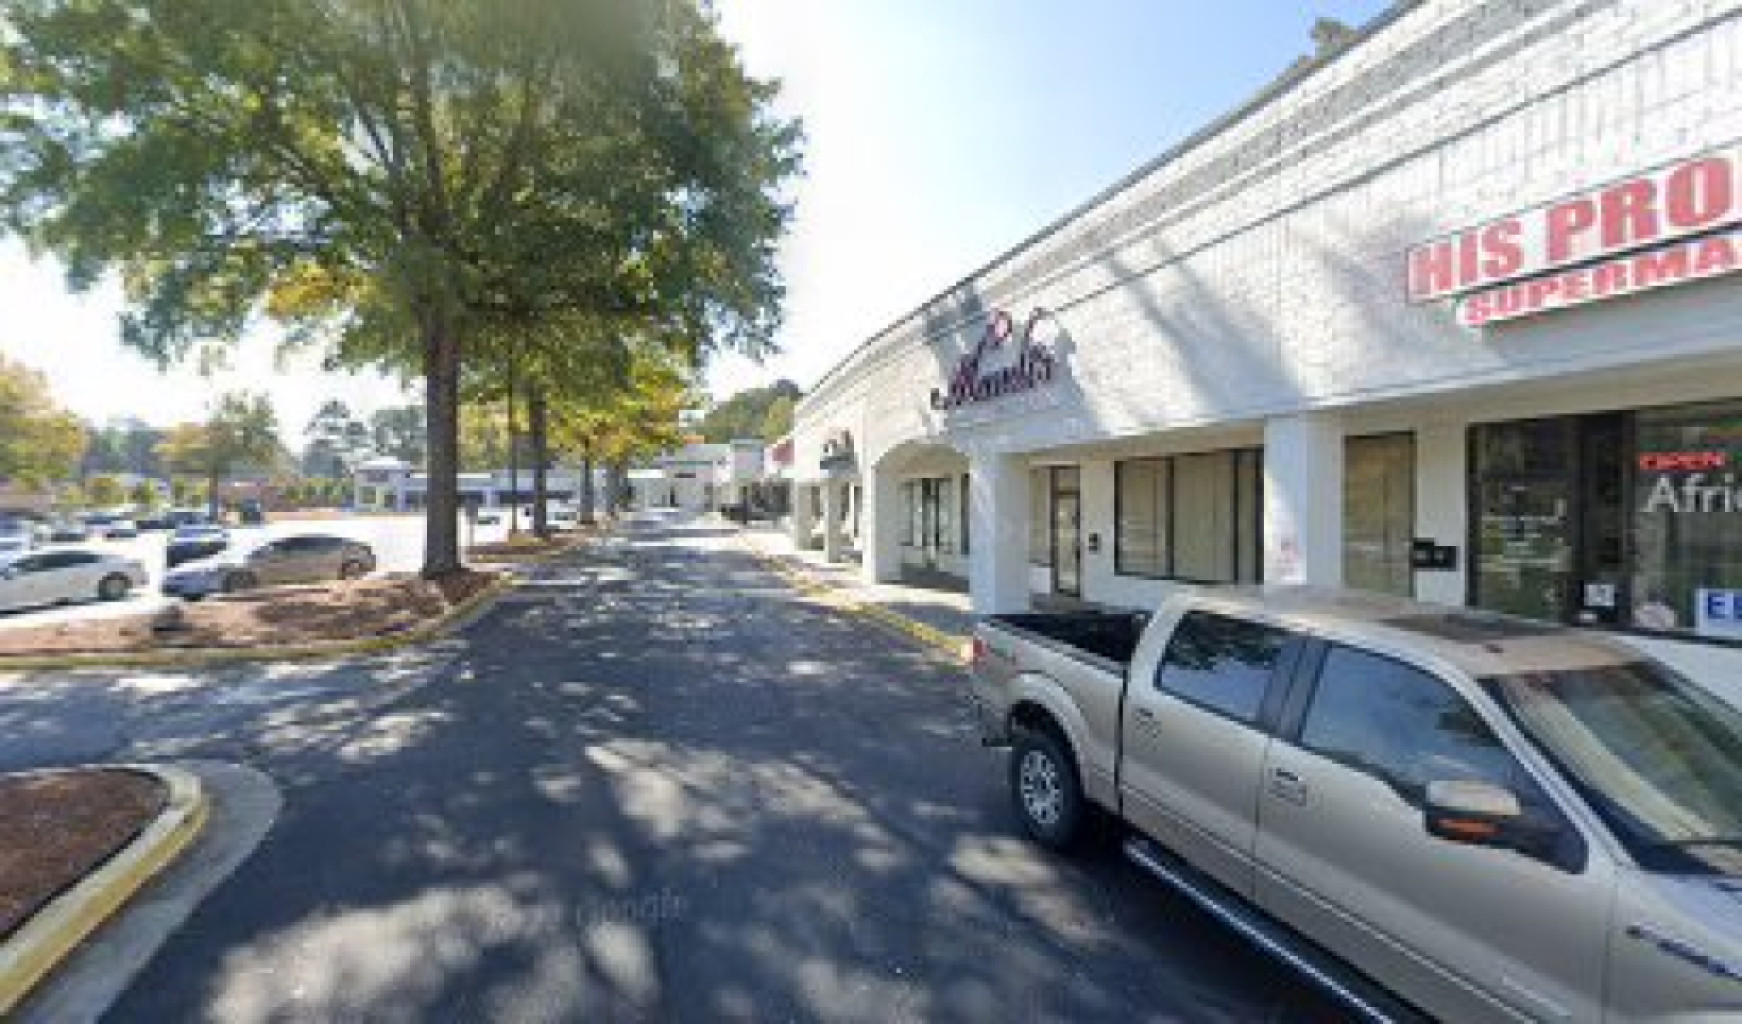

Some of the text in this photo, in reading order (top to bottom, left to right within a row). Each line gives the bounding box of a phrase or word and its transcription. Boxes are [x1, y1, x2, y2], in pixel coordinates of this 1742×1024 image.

[1411, 158, 1732, 295] HIS PRO
[1464, 239, 1737, 325] SUPERMA
[1639, 452, 1726, 471] OPEN
